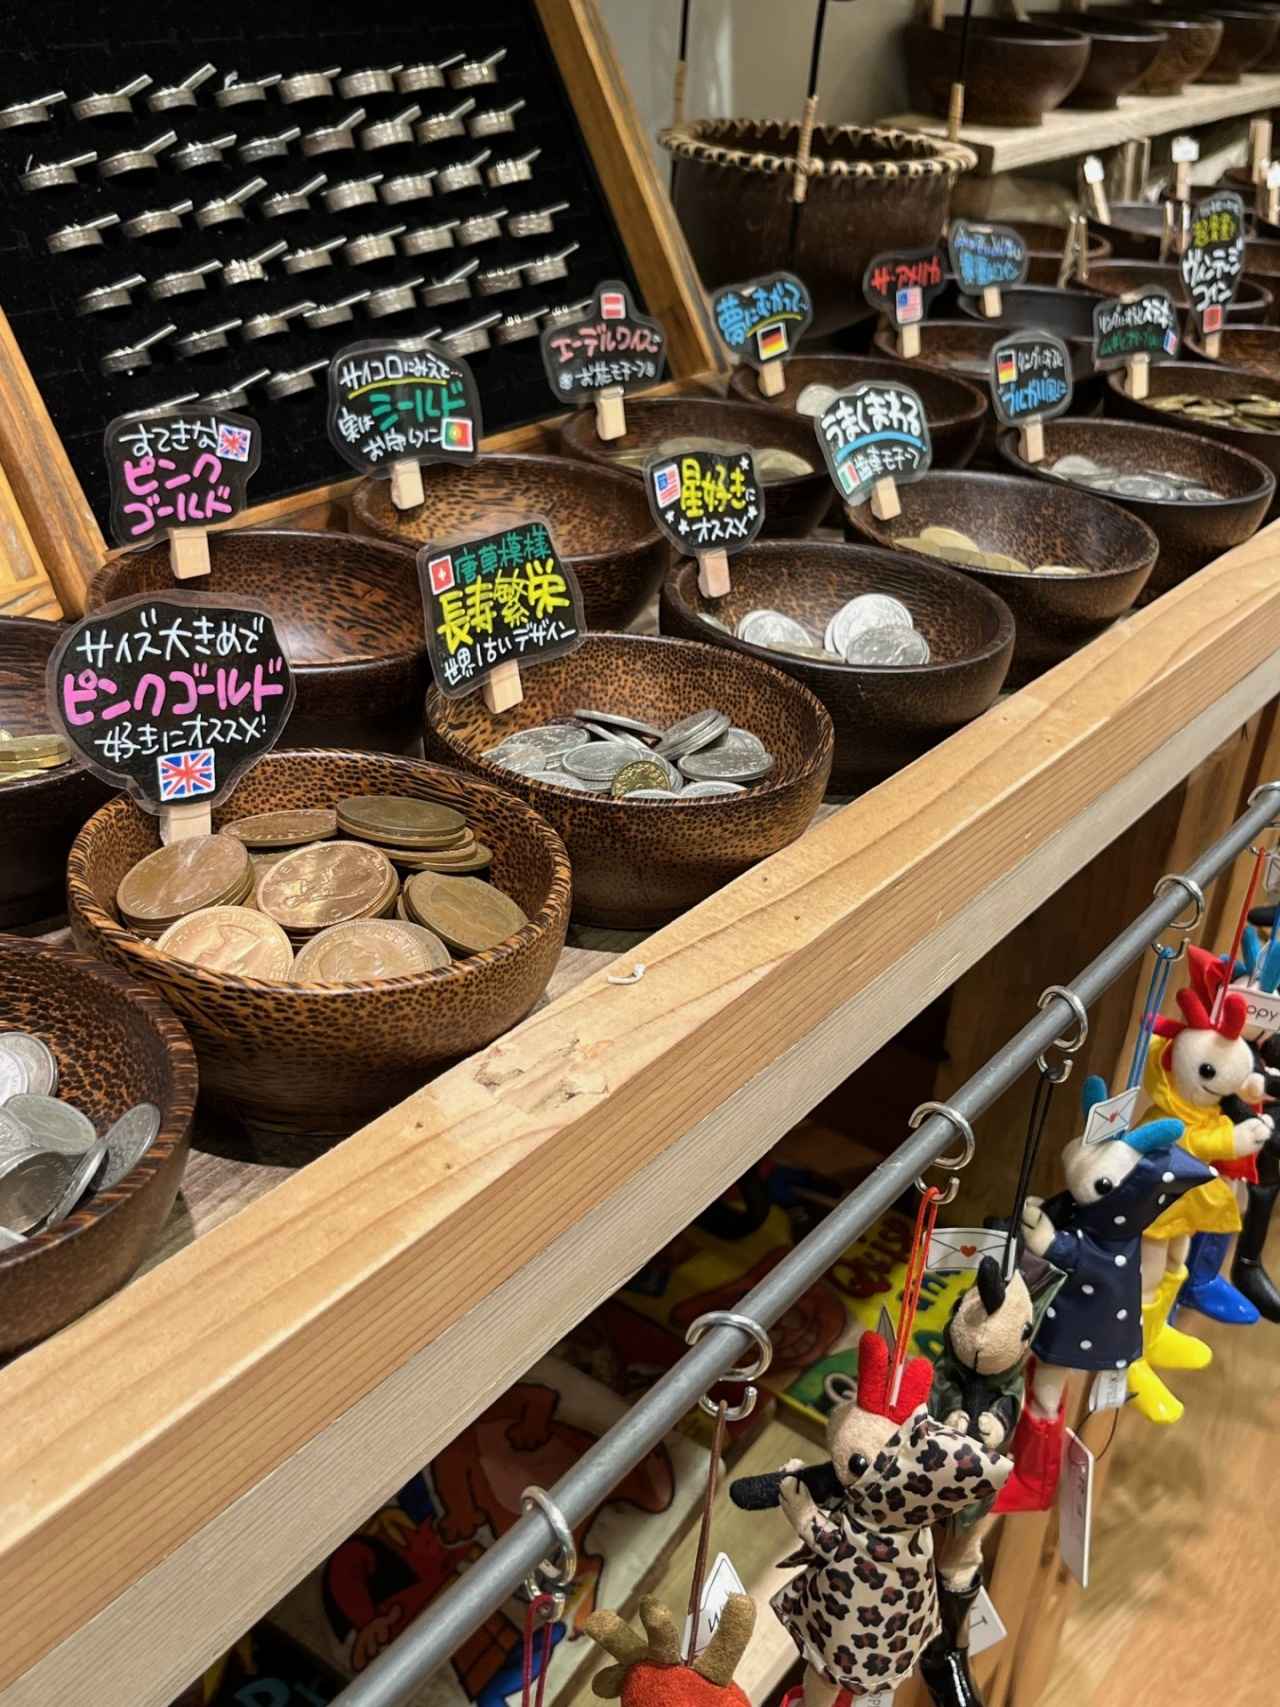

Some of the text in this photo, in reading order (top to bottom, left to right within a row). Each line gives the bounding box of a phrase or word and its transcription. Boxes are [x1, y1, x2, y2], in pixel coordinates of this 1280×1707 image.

[119, 417, 219, 457] すてきな
[338, 406, 375, 443] 実は
[362, 427, 443, 462] お守りに
[124, 453, 222, 496] ピンク
[124, 486, 232, 536] ゴールド
[692, 516, 748, 543] オススメ
[437, 558, 570, 655] 長寿繁栄
[76, 608, 264, 668] サイズ大きめで
[64, 656, 283, 726] ピンクゴールド
